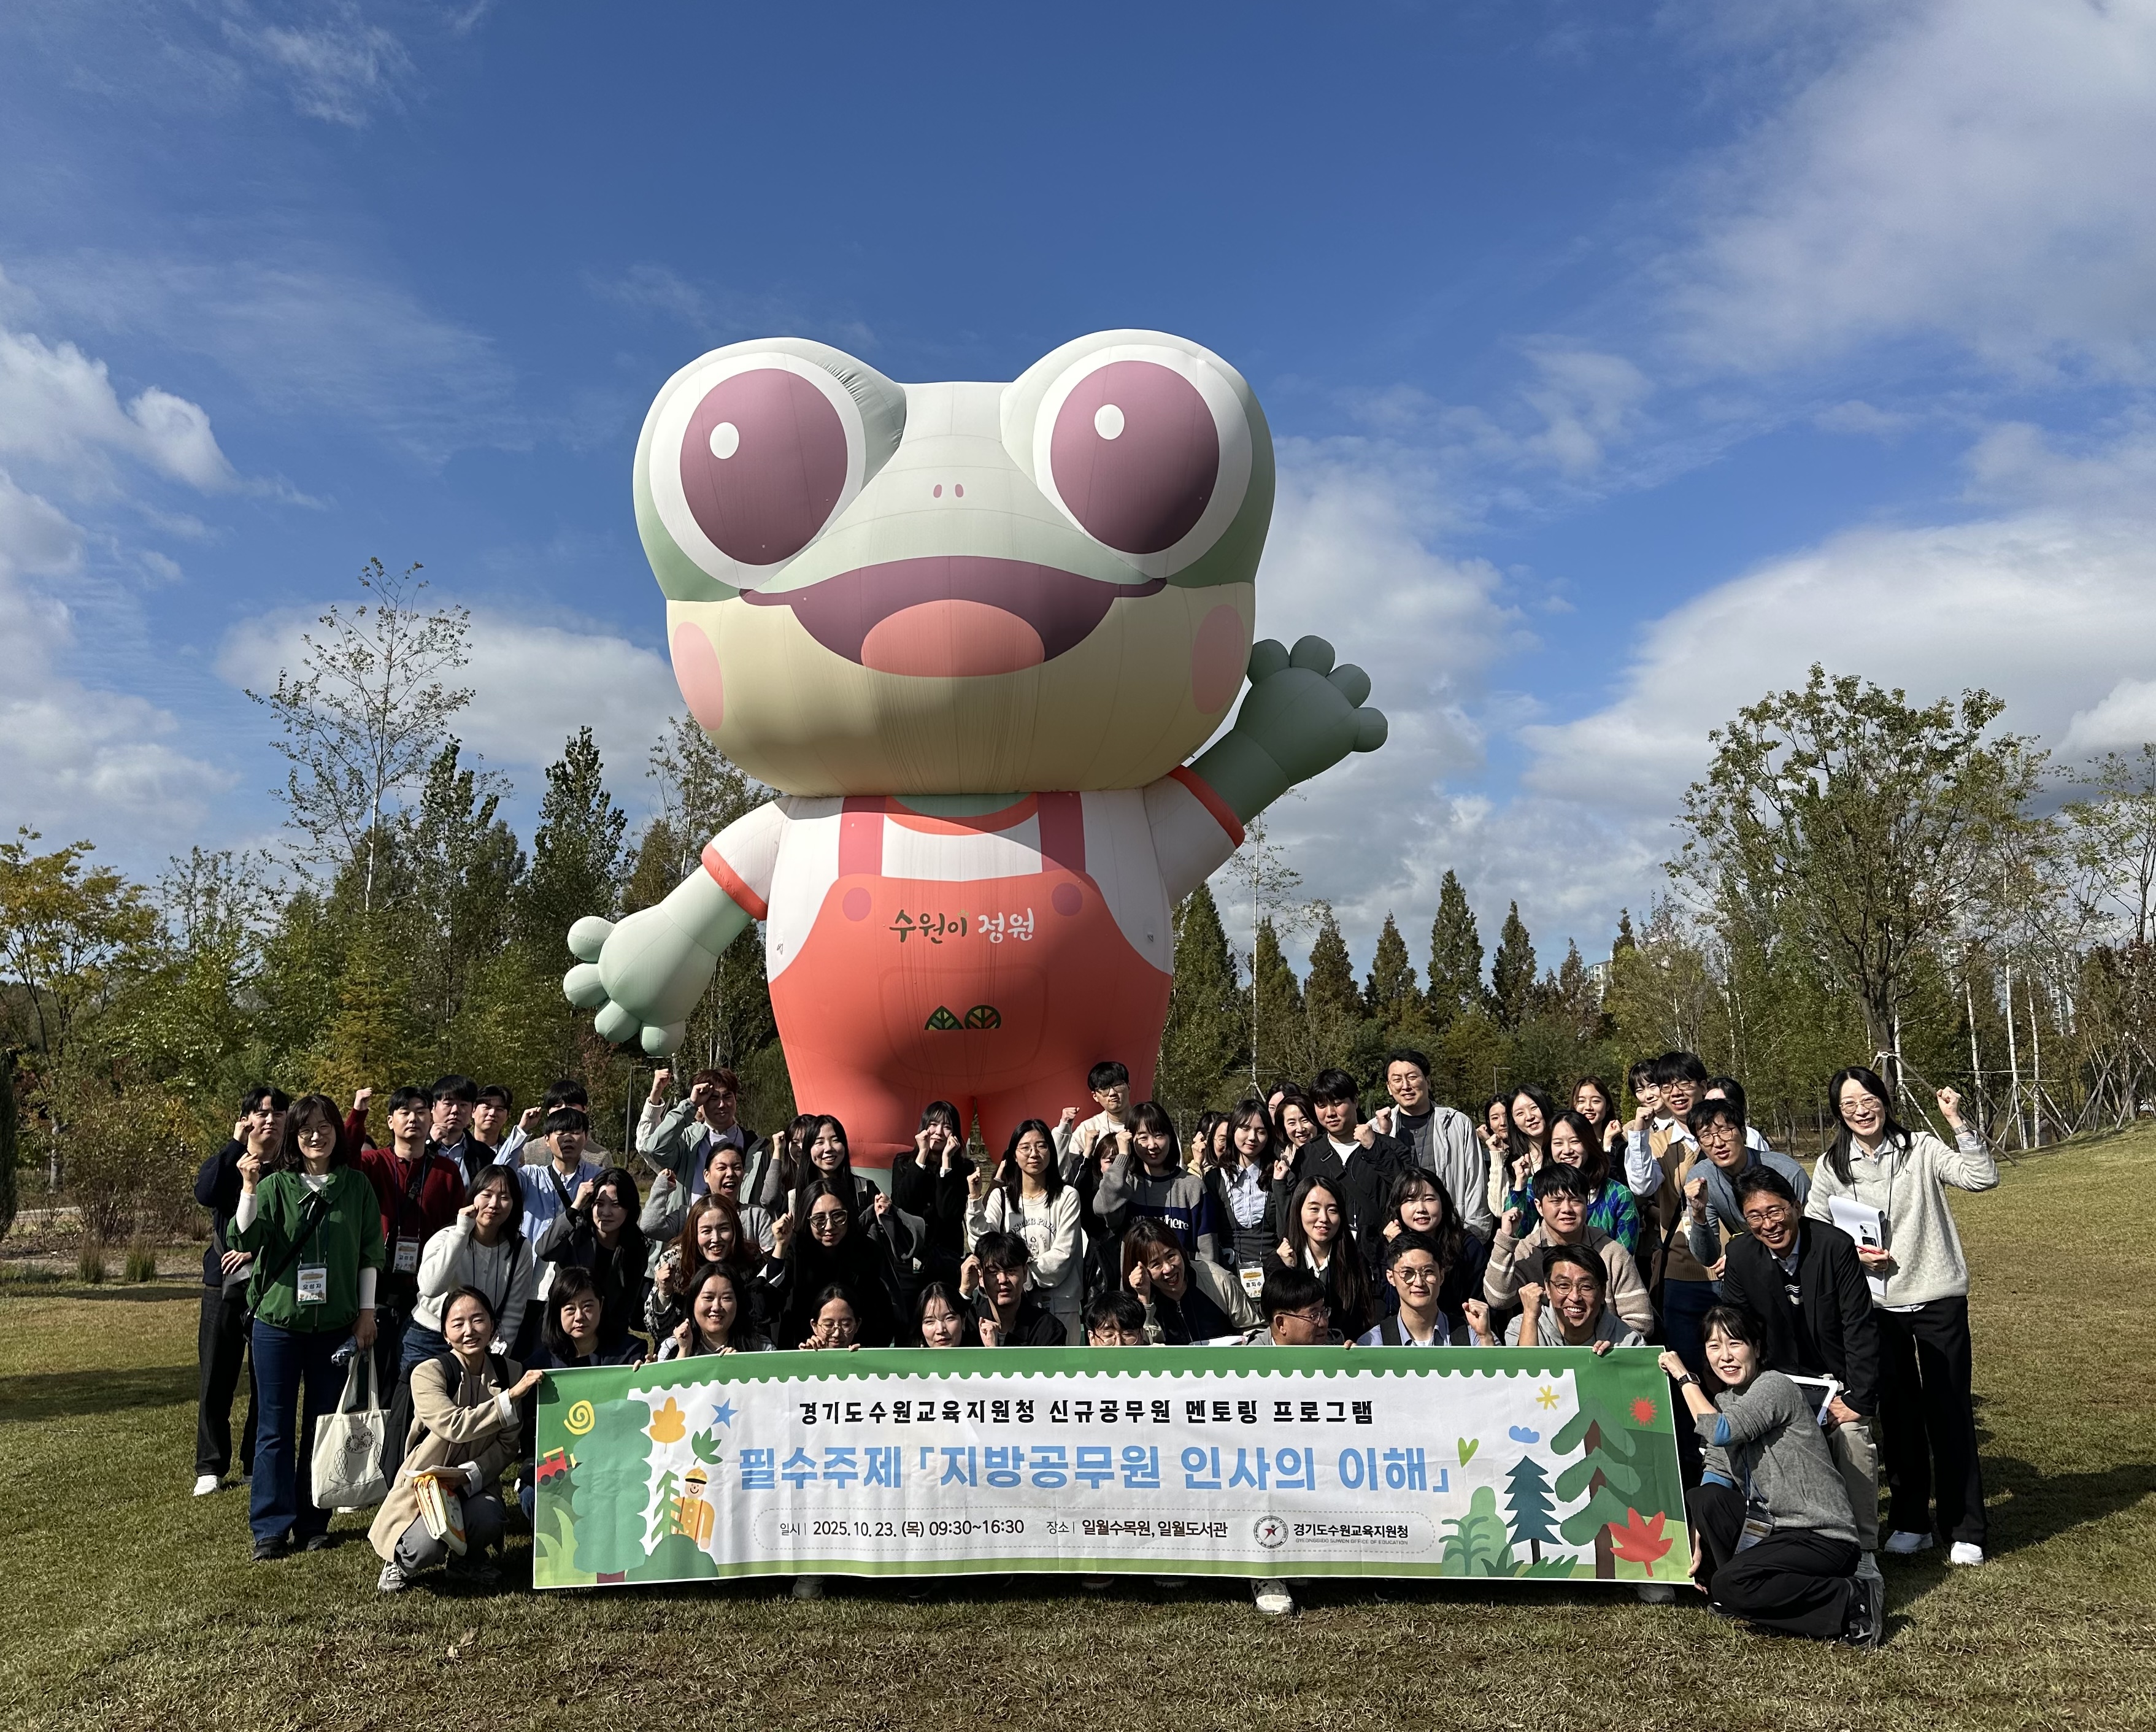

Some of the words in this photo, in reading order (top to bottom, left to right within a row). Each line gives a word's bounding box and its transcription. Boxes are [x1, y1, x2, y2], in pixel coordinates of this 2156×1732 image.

[889, 909, 968, 944] 수원이
[978, 907, 1034, 944] 정원
[1130, 1214, 1189, 1230] ohere
[799, 1399, 1035, 1425] 경기도수원교육지원청
[1049, 1399, 1171, 1424] 신규공무원
[1186, 1399, 1258, 1424] 멘토링
[1273, 1400, 1373, 1425] 프로그램
[739, 1446, 901, 1490] 필수주제
[920, 1445, 1161, 1489] 「지방공무원
[1180, 1446, 1316, 1491] 인사의
[1338, 1447, 1449, 1493] 이해」
[780, 1522, 800, 1536] 일시
[901, 1520, 924, 1538] (목)
[929, 1519, 1025, 1536] 09:30~16:30
[1046, 1521, 1070, 1534] 장소
[1082, 1518, 1155, 1538] 일월수목원,
[1157, 1520, 1228, 1538] 일월도서관
[1293, 1523, 1409, 1538] 경기도수원교육지원청
